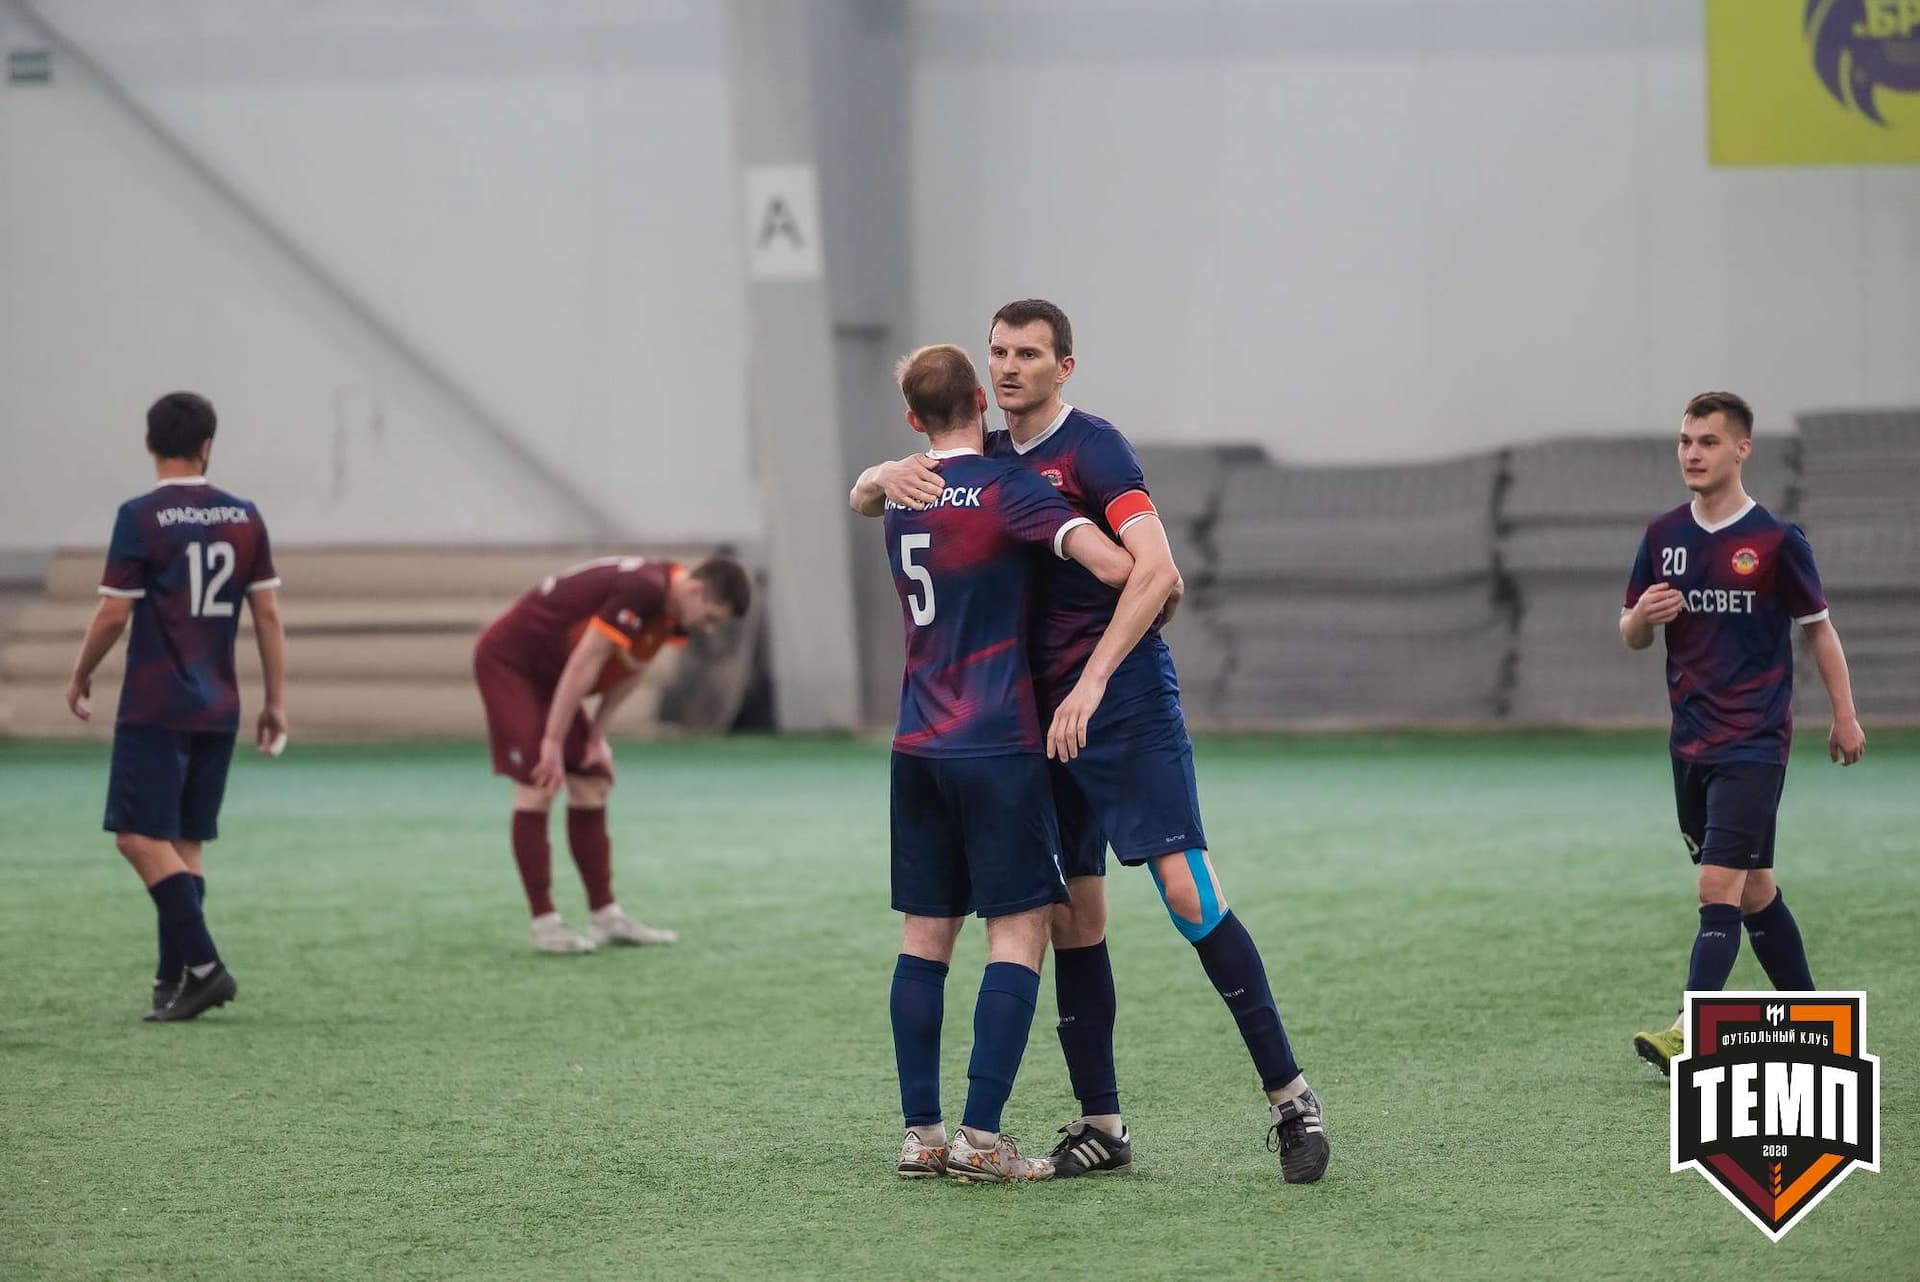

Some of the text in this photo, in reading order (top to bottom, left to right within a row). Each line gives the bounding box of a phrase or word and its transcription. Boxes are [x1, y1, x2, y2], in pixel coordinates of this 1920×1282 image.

[185, 541, 235, 617] 12
[900, 533, 936, 626] 5
[1662, 547, 1688, 576] 20
[1679, 589, 1756, 614] АССВЕТ
